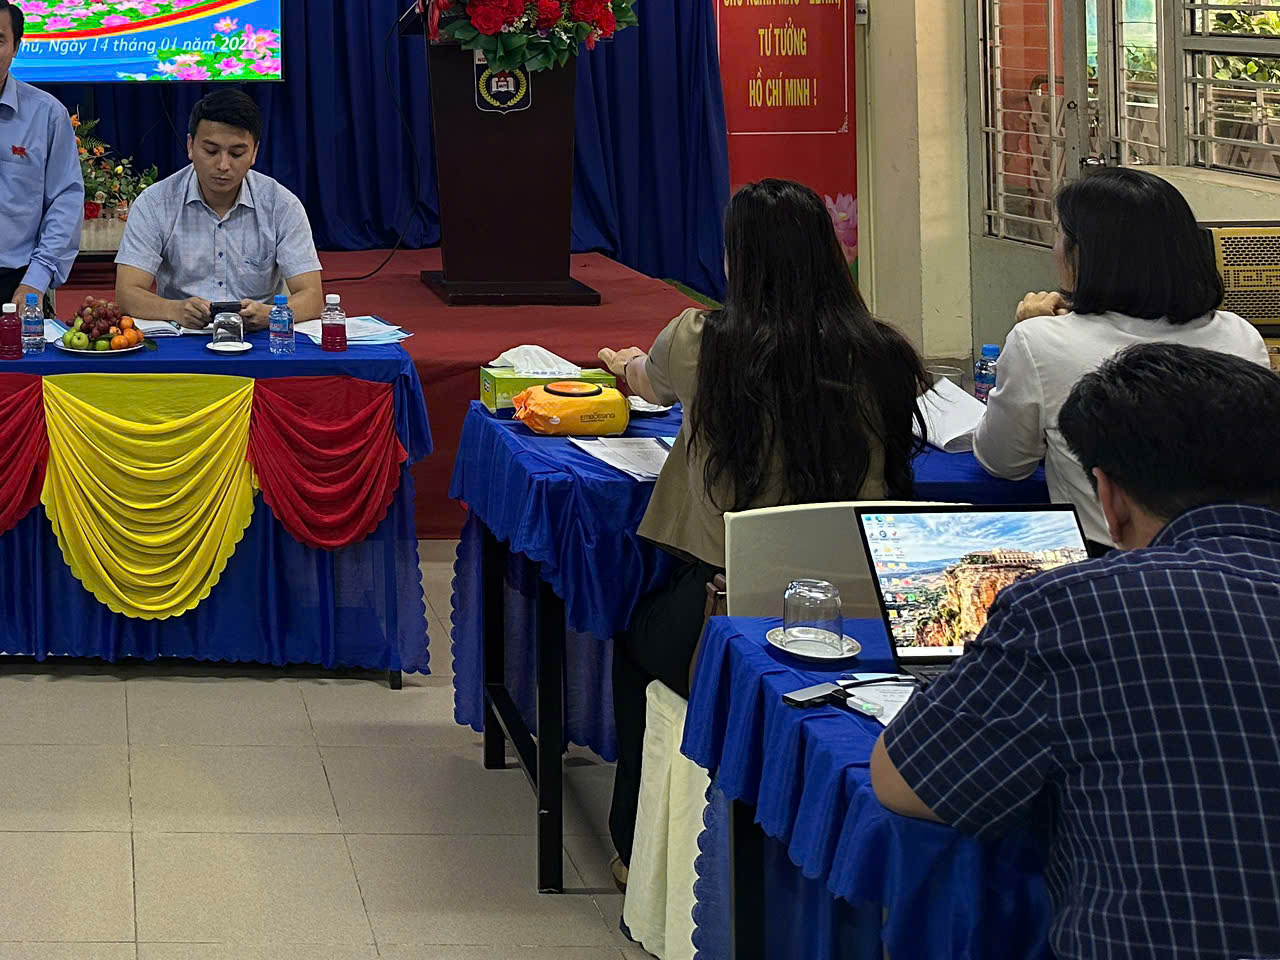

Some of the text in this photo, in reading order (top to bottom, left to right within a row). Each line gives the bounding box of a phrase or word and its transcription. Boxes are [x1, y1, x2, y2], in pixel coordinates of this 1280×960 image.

[48, 38, 87, 55] Ngày
[92, 36, 108, 52] 14
[112, 37, 156, 54] tháng
[160, 36, 176, 51] 01
[182, 38, 216, 50] năm
[758, 17, 807, 56] TƯ TƯỞNG
[749, 66, 763, 108] HỒ
[765, 71, 782, 108] CHÍ
[785, 78, 810, 108] MINH
